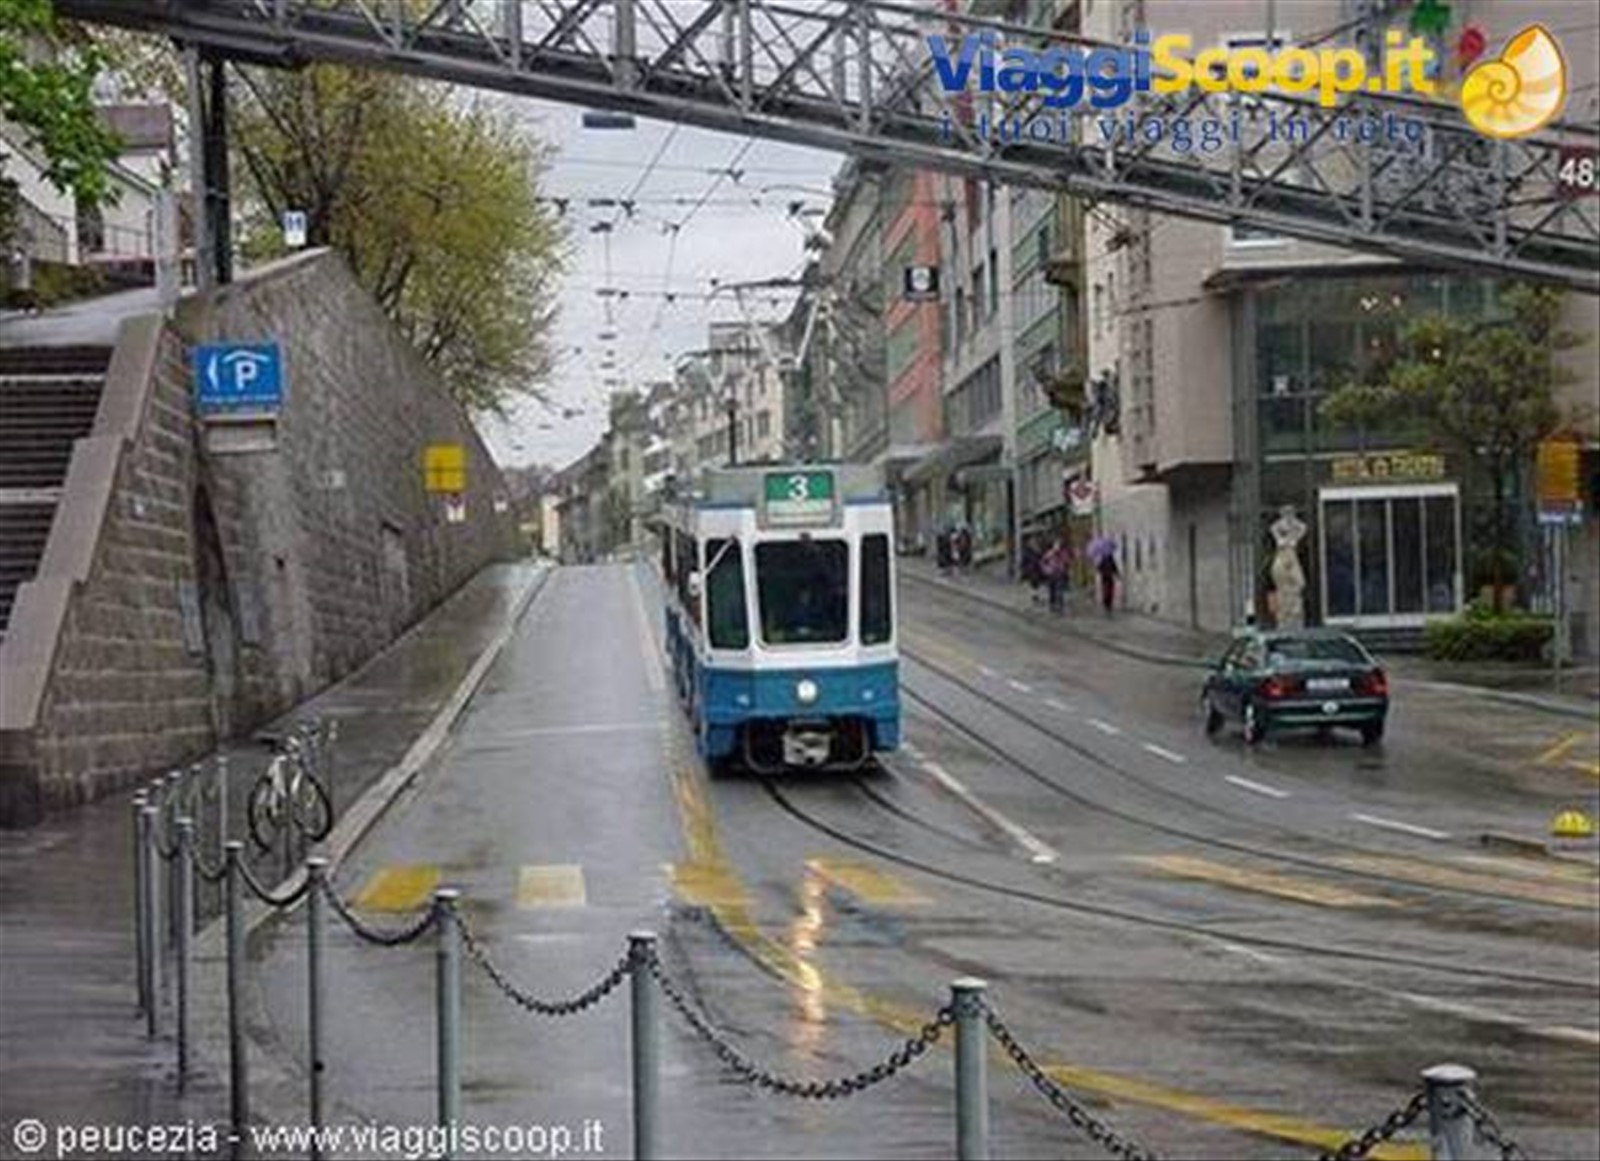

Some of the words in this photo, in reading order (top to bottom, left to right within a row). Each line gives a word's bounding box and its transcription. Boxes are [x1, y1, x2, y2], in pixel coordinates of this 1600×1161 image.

[1559, 158, 1595, 187] 48
[235, 361, 257, 390] P
[789, 475, 809, 501] 3
